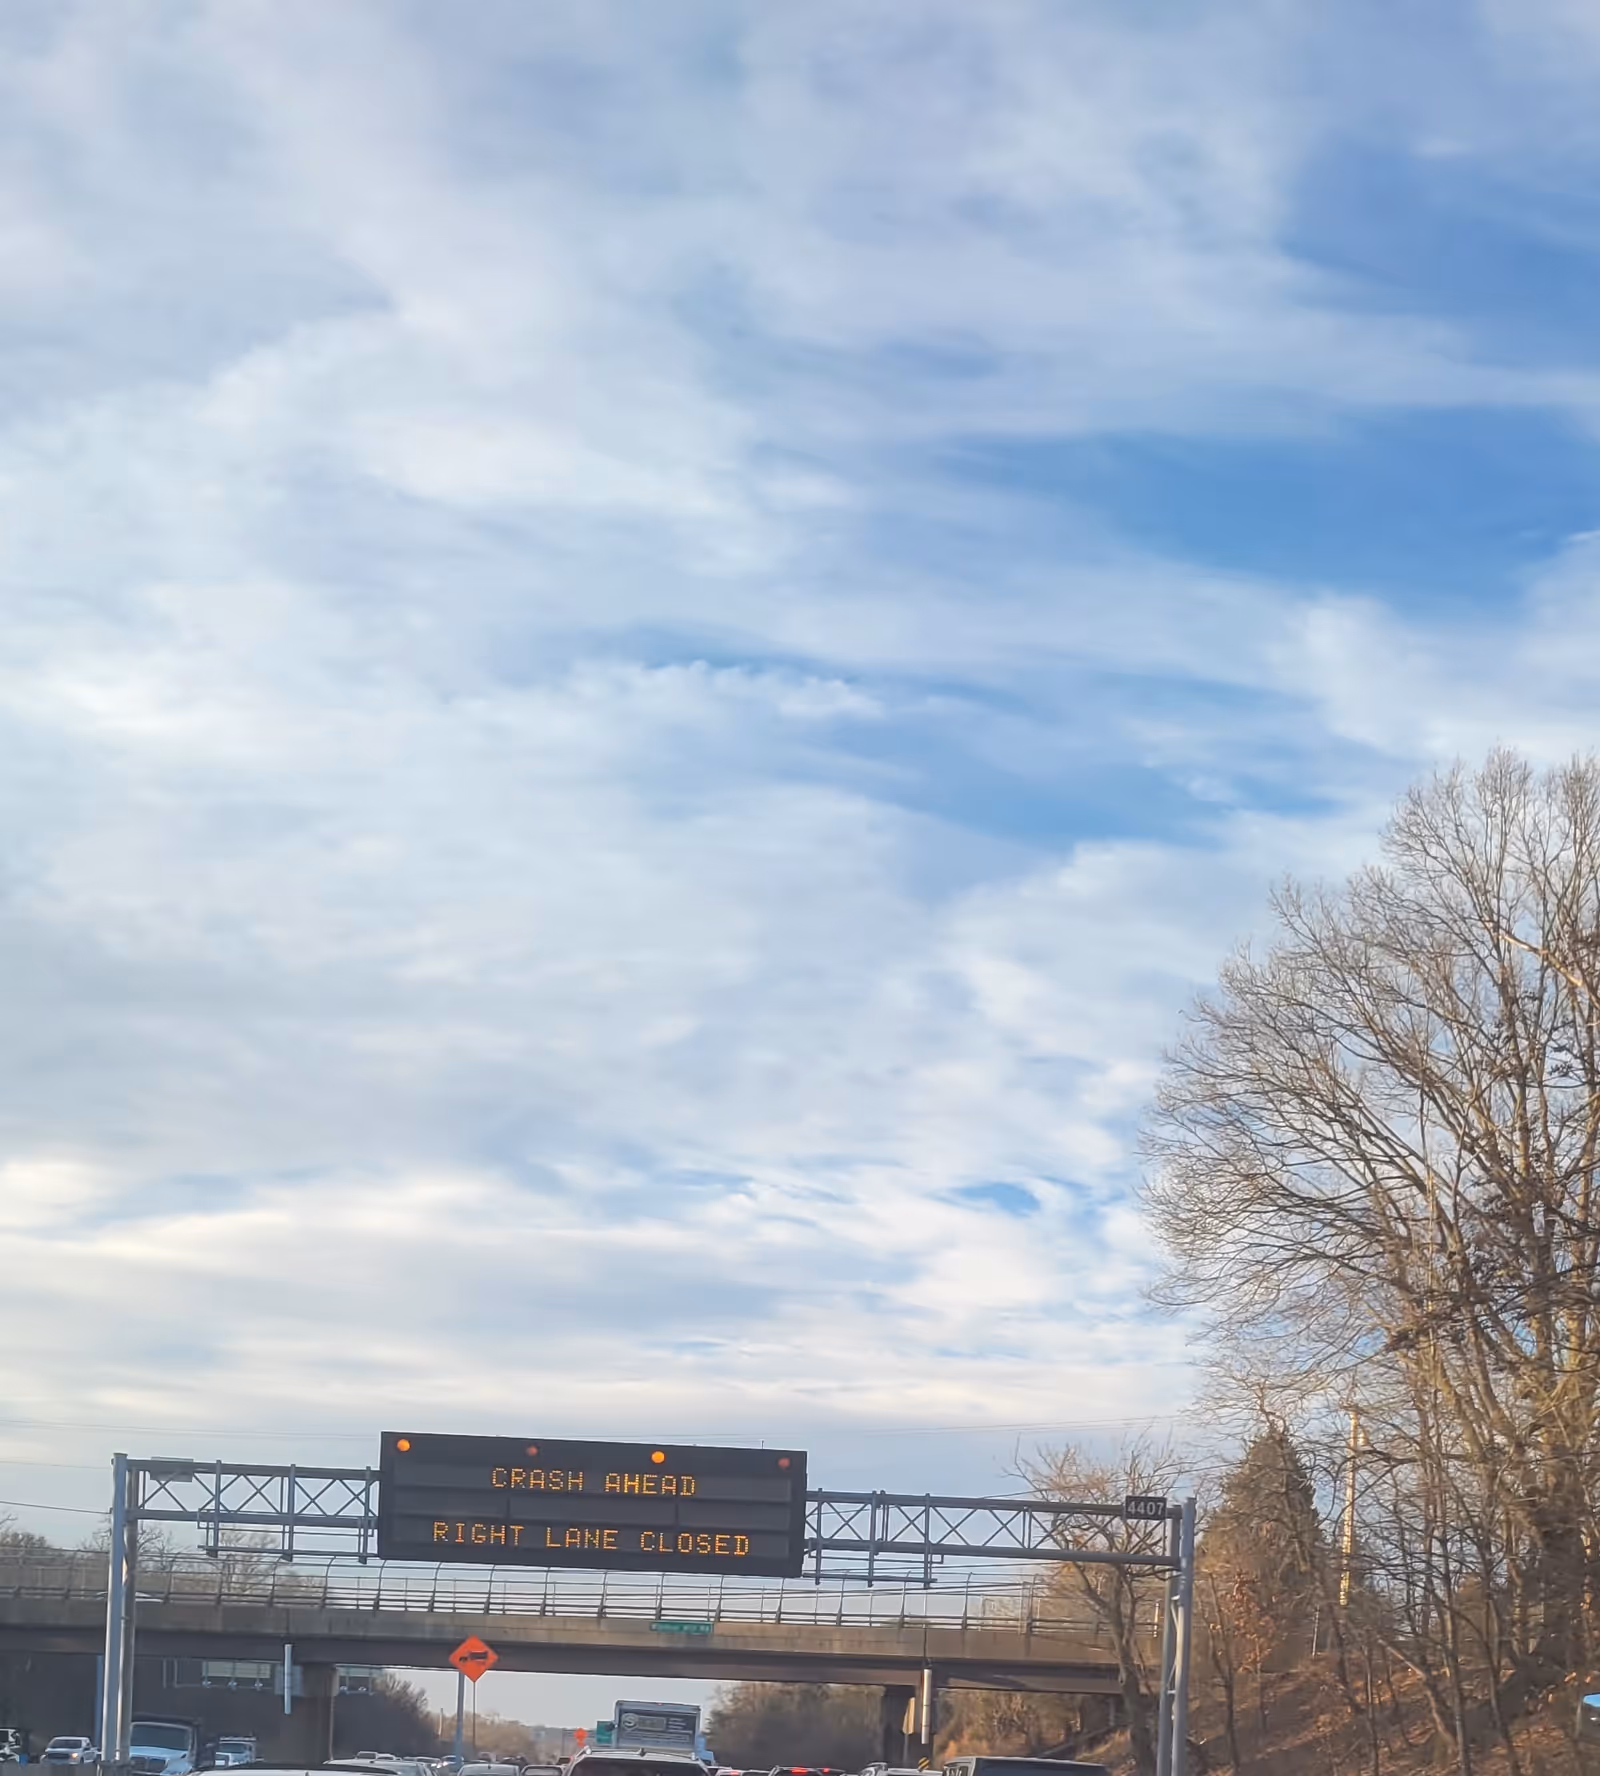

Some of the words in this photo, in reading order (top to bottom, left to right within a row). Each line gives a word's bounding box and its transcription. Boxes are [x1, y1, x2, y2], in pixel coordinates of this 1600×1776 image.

[491, 1467, 584, 1492] CRASH
[604, 1473, 696, 1497] AHEAD
[1127, 1501, 1164, 1516] 4407
[432, 1521, 525, 1546] RIGHT
[546, 1527, 619, 1550] LANE
[640, 1531, 749, 1556] CLOSED
